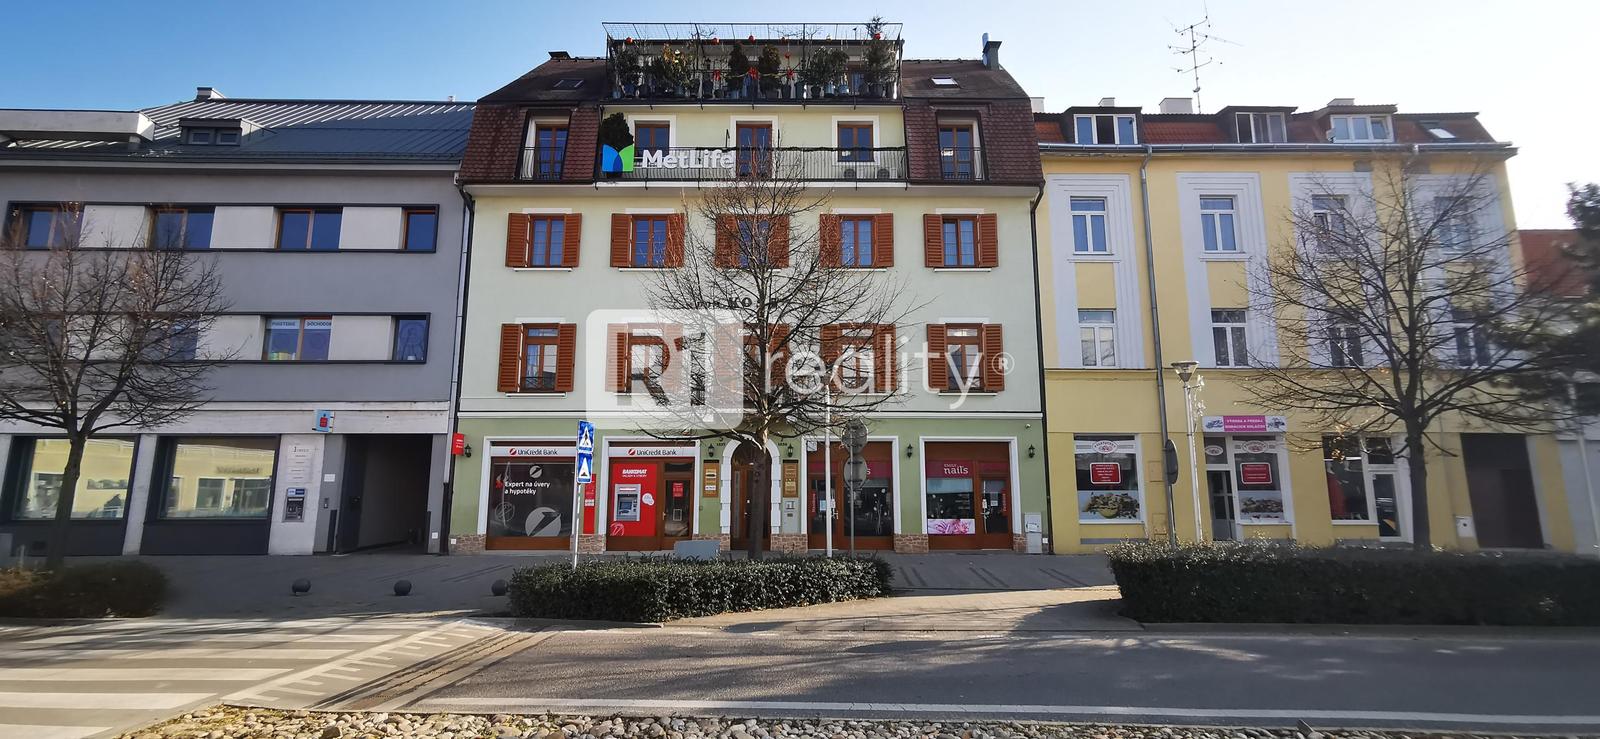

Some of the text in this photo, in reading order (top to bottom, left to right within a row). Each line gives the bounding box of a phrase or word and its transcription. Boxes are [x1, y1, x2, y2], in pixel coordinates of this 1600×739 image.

[641, 149, 734, 169] MetLife
[943, 465, 969, 475] nails
[533, 480, 551, 489] úvery
